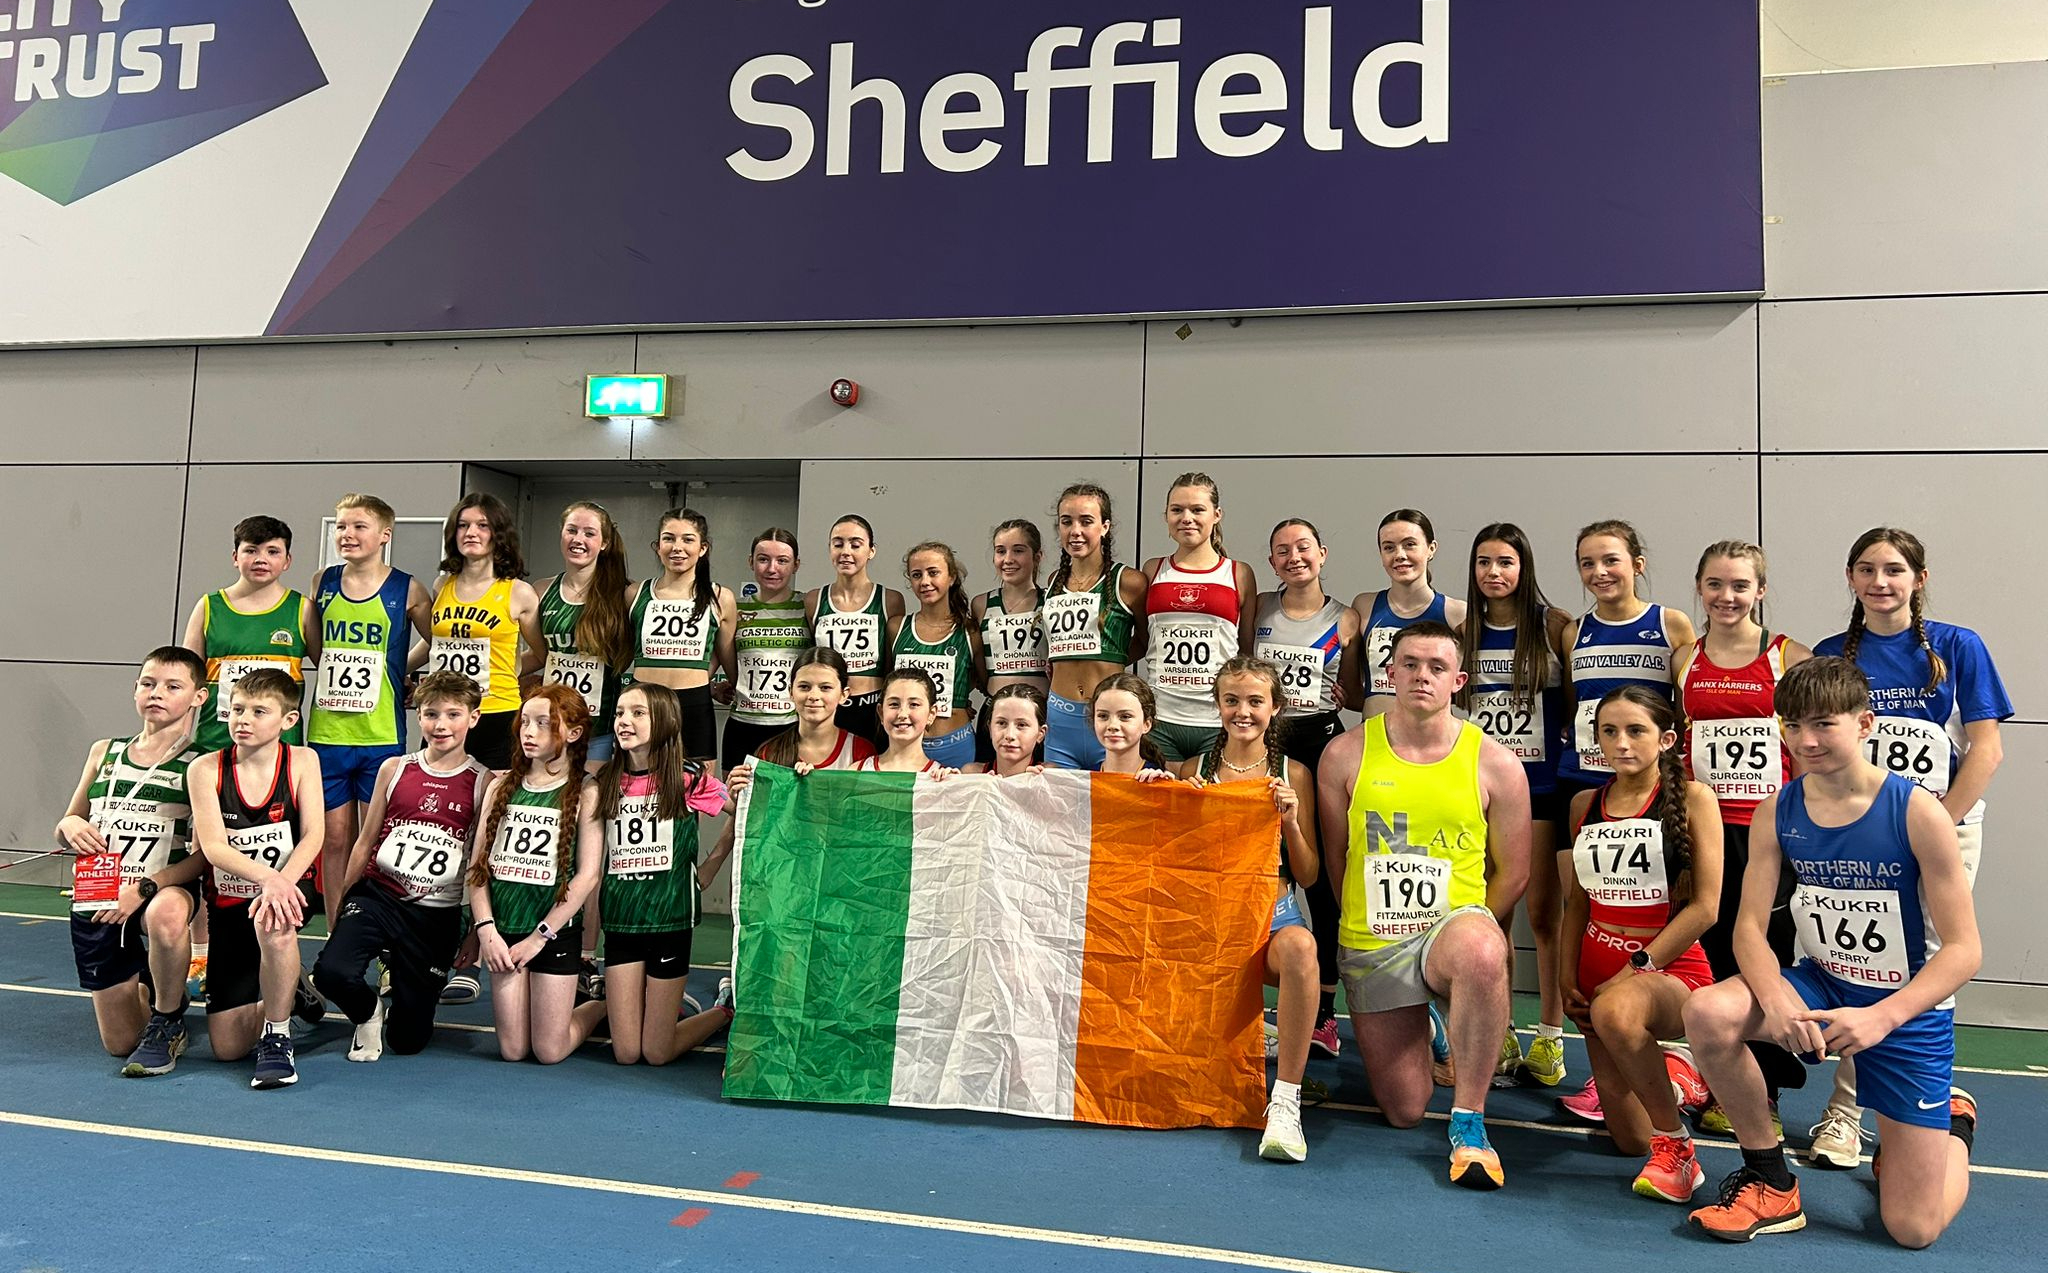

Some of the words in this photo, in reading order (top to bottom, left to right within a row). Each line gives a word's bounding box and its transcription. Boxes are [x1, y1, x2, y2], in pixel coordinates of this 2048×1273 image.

[0, 23, 216, 102] RUST
[725, 0, 1449, 181] Sheffield
[1056, 597, 1093, 607] KUKRI
[433, 606, 501, 630] BANDON
[831, 617, 873, 626] KUKRI
[1049, 608, 1090, 634] 209
[325, 619, 383, 645] MSB
[741, 628, 805, 637] CASTLEGAR
[826, 628, 869, 650] 175
[999, 627, 1044, 651] 199
[1169, 628, 1213, 638] KUKRI
[445, 642, 484, 651] KUKRI
[645, 646, 701, 656] SHEFFIELD
[738, 639, 782, 649] ATHLETIC
[1050, 641, 1097, 654] SHEFFIELD
[333, 653, 377, 665] KUKRI
[1163, 641, 1210, 665] 200
[1273, 649, 1318, 663] KUKRI
[436, 653, 480, 676] 208
[557, 657, 599, 669] KUKRI
[752, 657, 792, 668] KUKRI
[908, 659, 949, 670] KUKRI
[995, 660, 1047, 670] SHEFFIELD
[1482, 659, 1514, 674] VALLE
[1597, 654, 1642, 668] VALLEY
[1643, 655, 1665, 671] A.C.
[1164, 666, 1209, 674] VARSBERGA
[1280, 663, 1312, 688] 68
[326, 665, 371, 690] 163
[747, 670, 788, 692] 173
[1159, 675, 1216, 685] SHEFFIELD
[1692, 681, 1717, 689] MANX
[1718, 682, 1763, 692] HARRIERS
[1868, 687, 1916, 700] RTHERN
[328, 690, 363, 698] MCNULTY
[749, 692, 780, 700] MADDEN
[318, 698, 374, 709] SHEFFIELD
[739, 701, 792, 710] SHEFFIELD
[1886, 700, 1901, 710] OF
[1903, 699, 1927, 709] MAN
[1477, 710, 1533, 736] 202
[1713, 725, 1771, 737] KUKRI
[1705, 741, 1767, 770] 195
[1866, 739, 1934, 774] 186
[1710, 772, 1762, 780] SURGEON
[1712, 782, 1777, 794] HEFFIELD
[513, 811, 560, 827] KUKRI
[227, 830, 283, 846] KUKRI
[614, 817, 658, 846] 181
[1597, 828, 1653, 839] KUKRI
[406, 829, 457, 849] KUKRI
[502, 826, 552, 857] 182
[93, 856, 115, 870] 25
[393, 841, 449, 876] 178
[611, 855, 669, 870] SHEFFIELD
[1587, 843, 1651, 874] 174
[77, 870, 114, 879] ATHLETE
[489, 864, 551, 881] SHEFFIELD
[1386, 861, 1442, 878] KUKRI
[1876, 862, 1902, 877] AC
[219, 882, 260, 894] SHEFF
[1603, 877, 1637, 886] DINKIN
[1833, 876, 1851, 888] OF
[1854, 877, 1888, 889] MAN
[1378, 877, 1437, 909] 190
[1586, 888, 1662, 901] SHEFFIELD
[1814, 895, 1889, 913] KUKRI
[1376, 910, 1442, 920] FITZMAURICE
[1809, 912, 1887, 953] 166
[1596, 932, 1643, 953] PRO
[1830, 949, 1870, 964] PERRY
